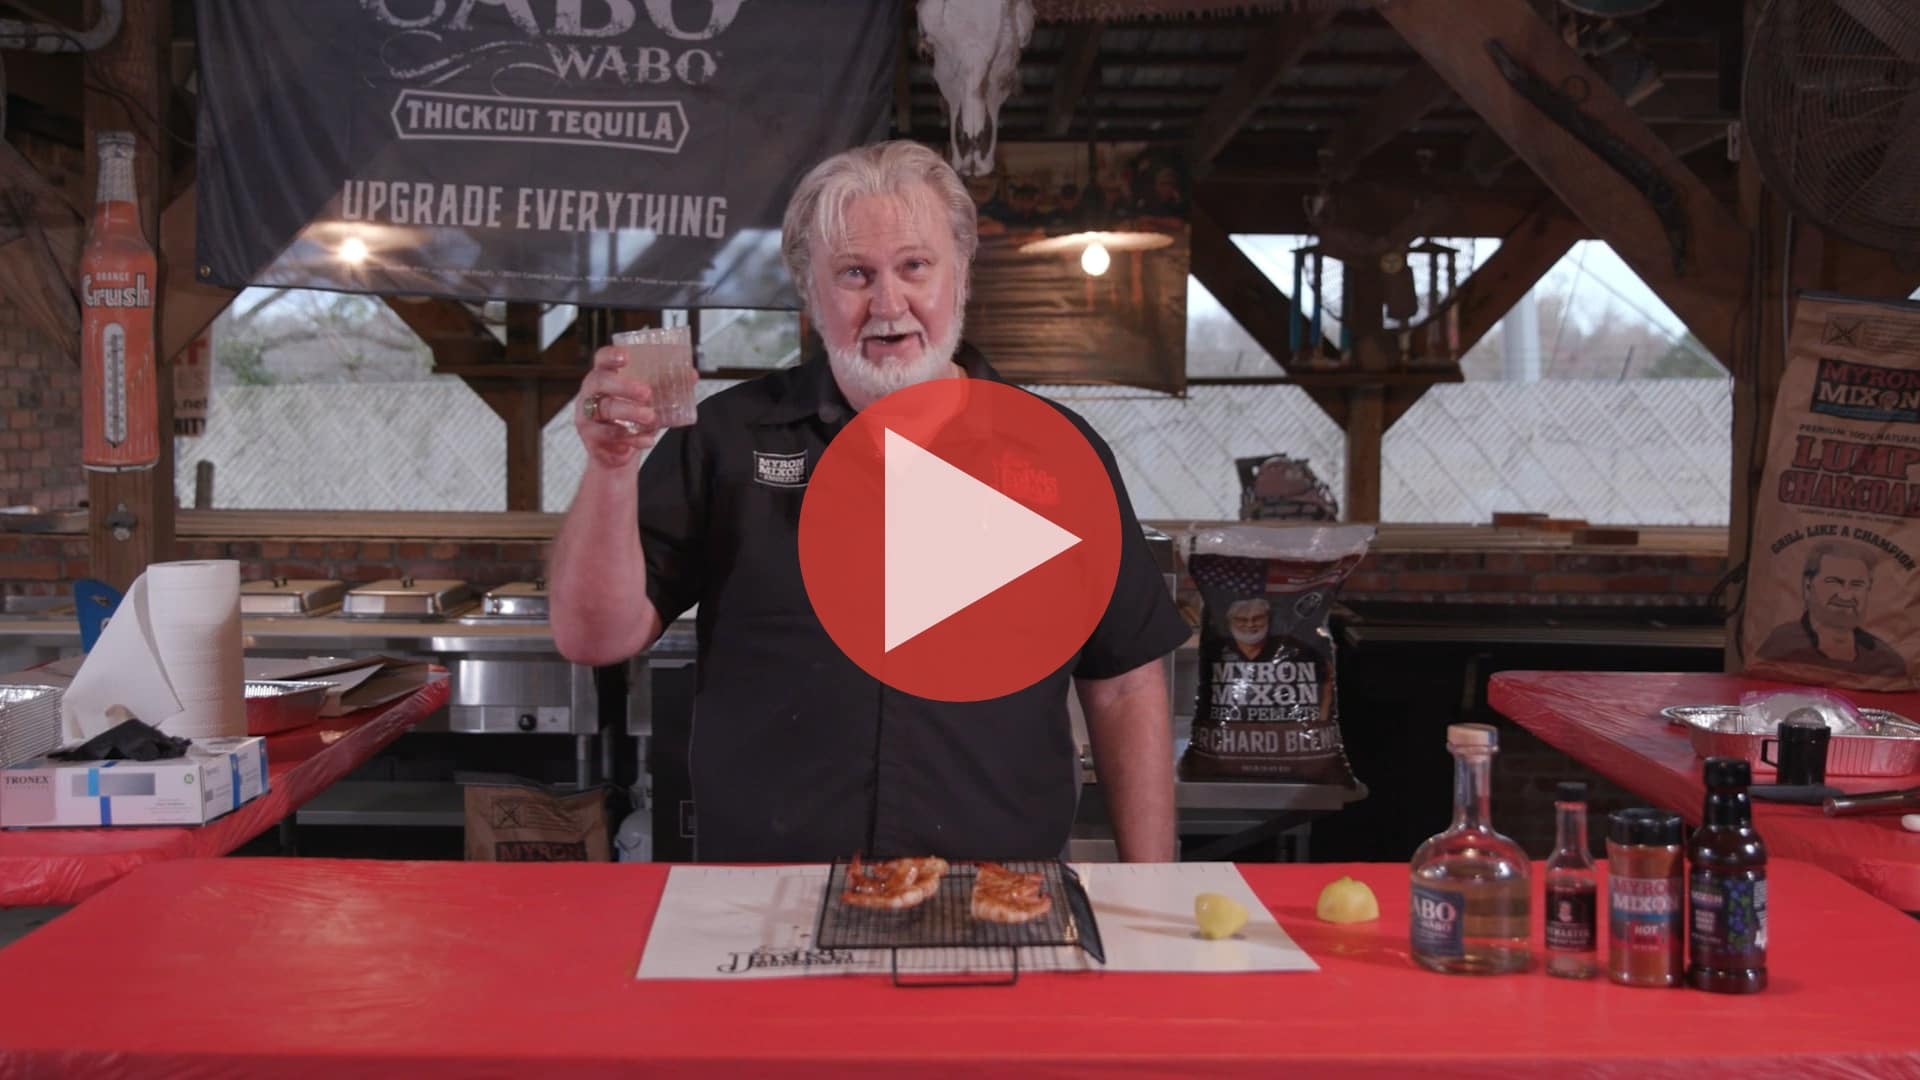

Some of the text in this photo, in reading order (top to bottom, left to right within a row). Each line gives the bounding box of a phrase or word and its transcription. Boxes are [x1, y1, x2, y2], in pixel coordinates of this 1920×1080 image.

[546, 42, 718, 85] WABO
[548, 108, 675, 141] TEQUILA
[342, 179, 729, 239] UPGRADE EVERYTHING
[83, 274, 150, 307] Crush
[96, 271, 129, 281] ORANGE
[1823, 362, 1920, 389] MYRON
[1817, 382, 1920, 411] MIXON
[1792, 434, 1920, 480] LUMP
[1770, 529, 1805, 554] GRILL
[1806, 525, 1838, 537] LIKE
[1841, 526, 1850, 537] A
[1211, 661, 1317, 683] MYRON
[1211, 683, 1319, 706] MIXON
[1248, 706, 1320, 722] PELLETS
[4, 775, 50, 785] TRONEX
